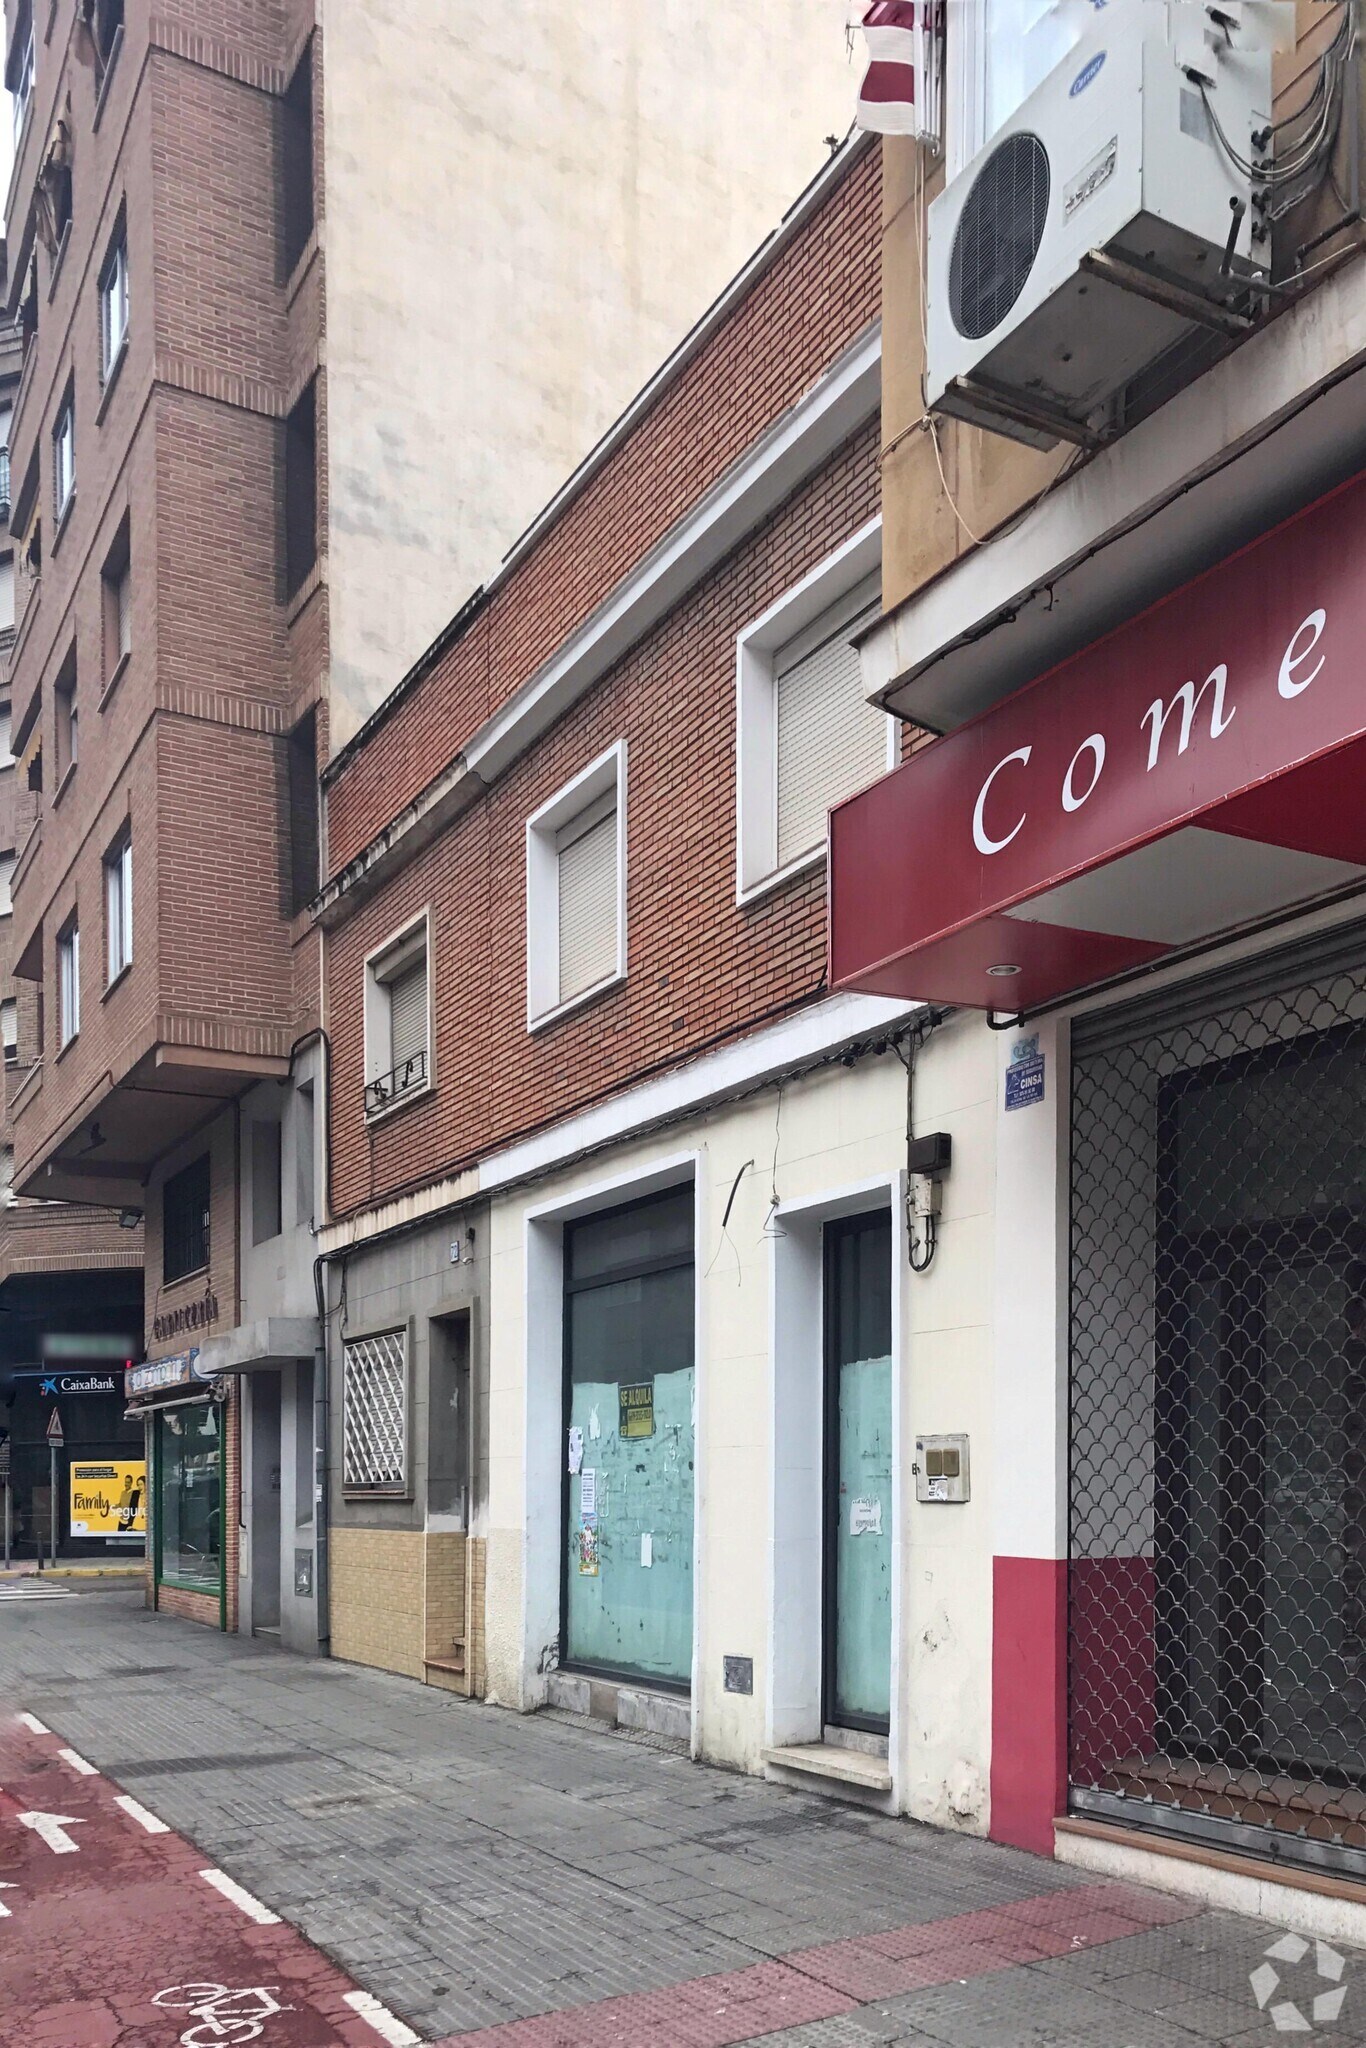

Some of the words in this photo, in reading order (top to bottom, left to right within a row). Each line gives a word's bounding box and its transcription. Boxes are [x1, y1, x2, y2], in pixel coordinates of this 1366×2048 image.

[972, 607, 1327, 855] Come
[1020, 1073, 1042, 1089] CINSA
[60, 1376, 115, 1391] CaixaBank
[620, 1390, 628, 1407] SE
[628, 1386, 652, 1406] ALQUILA
[74, 1490, 110, 1518] Family
